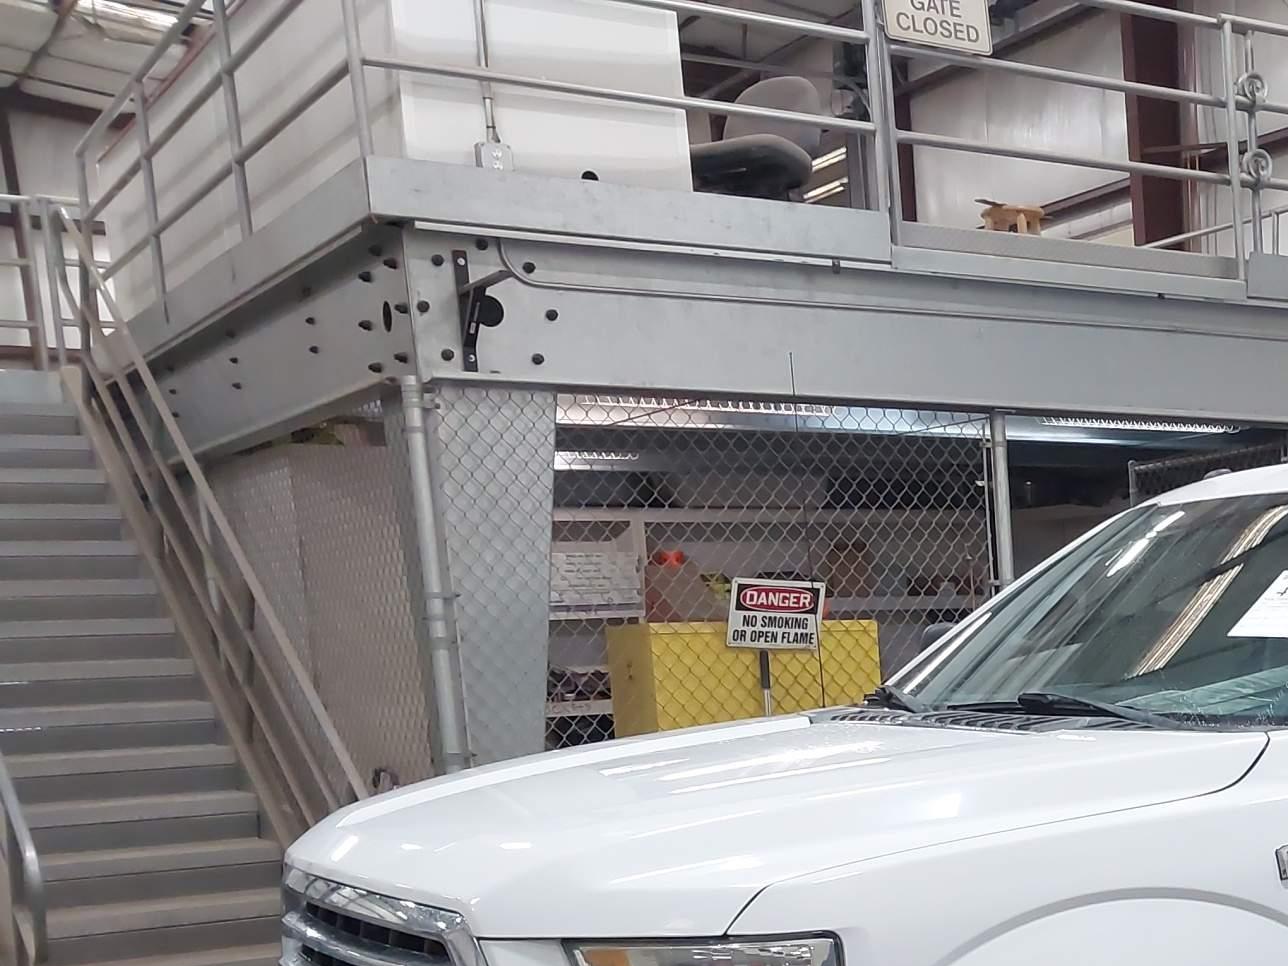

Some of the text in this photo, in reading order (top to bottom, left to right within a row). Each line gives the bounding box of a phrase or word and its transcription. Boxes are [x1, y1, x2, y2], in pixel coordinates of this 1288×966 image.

[911, 0, 962, 18] GATE
[896, 12, 980, 43] CLOSED
[745, 590, 811, 608] DANGER
[742, 614, 809, 630] NO SMOKING
[732, 629, 815, 645] OR OPEN FLAME
